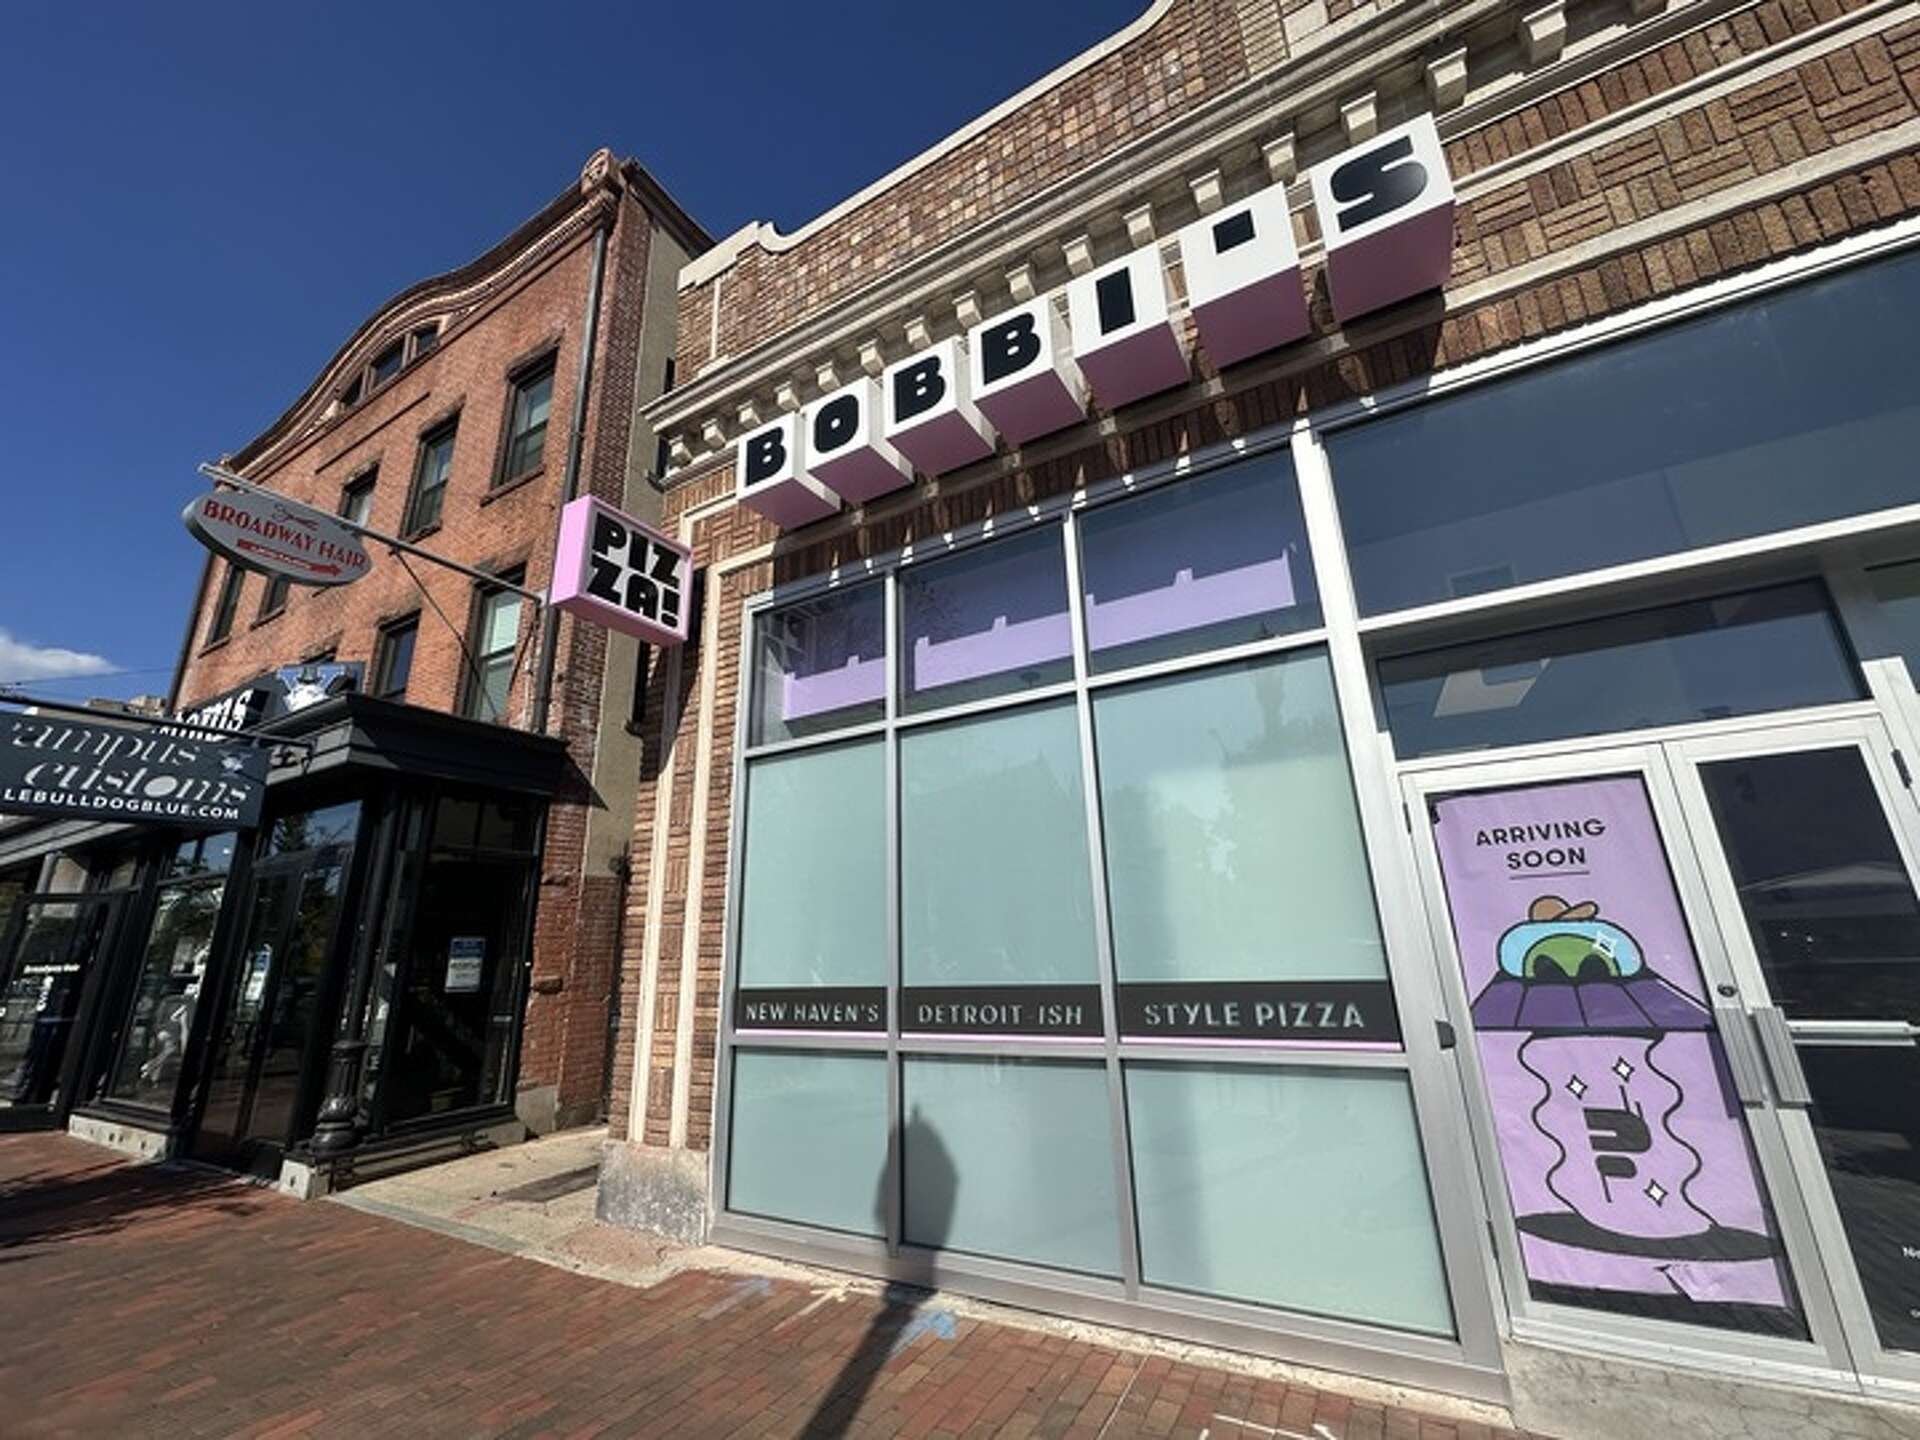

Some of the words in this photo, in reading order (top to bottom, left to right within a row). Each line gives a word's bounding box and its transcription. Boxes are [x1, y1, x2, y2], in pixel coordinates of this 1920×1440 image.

[745, 134, 1429, 487] BOBBI'S
[203, 499, 318, 552] BROADWAY
[319, 540, 366, 570] HAIR
[1476, 818, 1606, 846] ARRIVING
[1506, 847, 1586, 870] SOON
[746, 1002, 788, 1021] NEW
[793, 1003, 879, 1022] HAVEN'S
[918, 1004, 1023, 1025] DETROIT
[1143, 1002, 1241, 1026] STYLE
[1254, 1002, 1365, 1028] PIZZA
